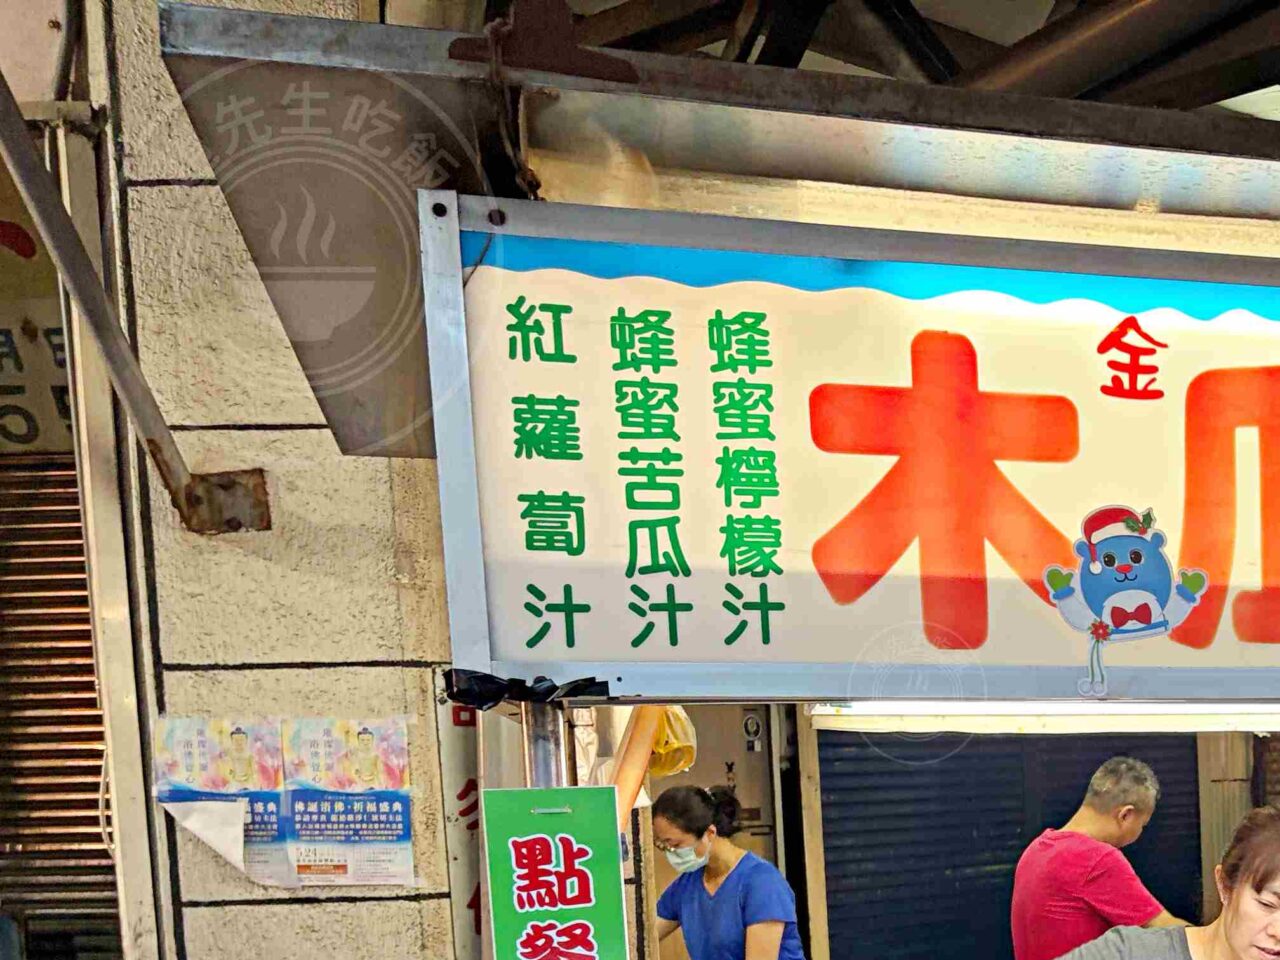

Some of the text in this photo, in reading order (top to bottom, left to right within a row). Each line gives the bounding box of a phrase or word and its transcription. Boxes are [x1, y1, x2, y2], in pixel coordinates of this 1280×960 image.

[505, 295, 591, 649] 紅蘿蔔汁
[609, 306, 694, 648] 蜂蜜苦瓜汁
[707, 309, 786, 646] 蜂蜜檸檬汁
